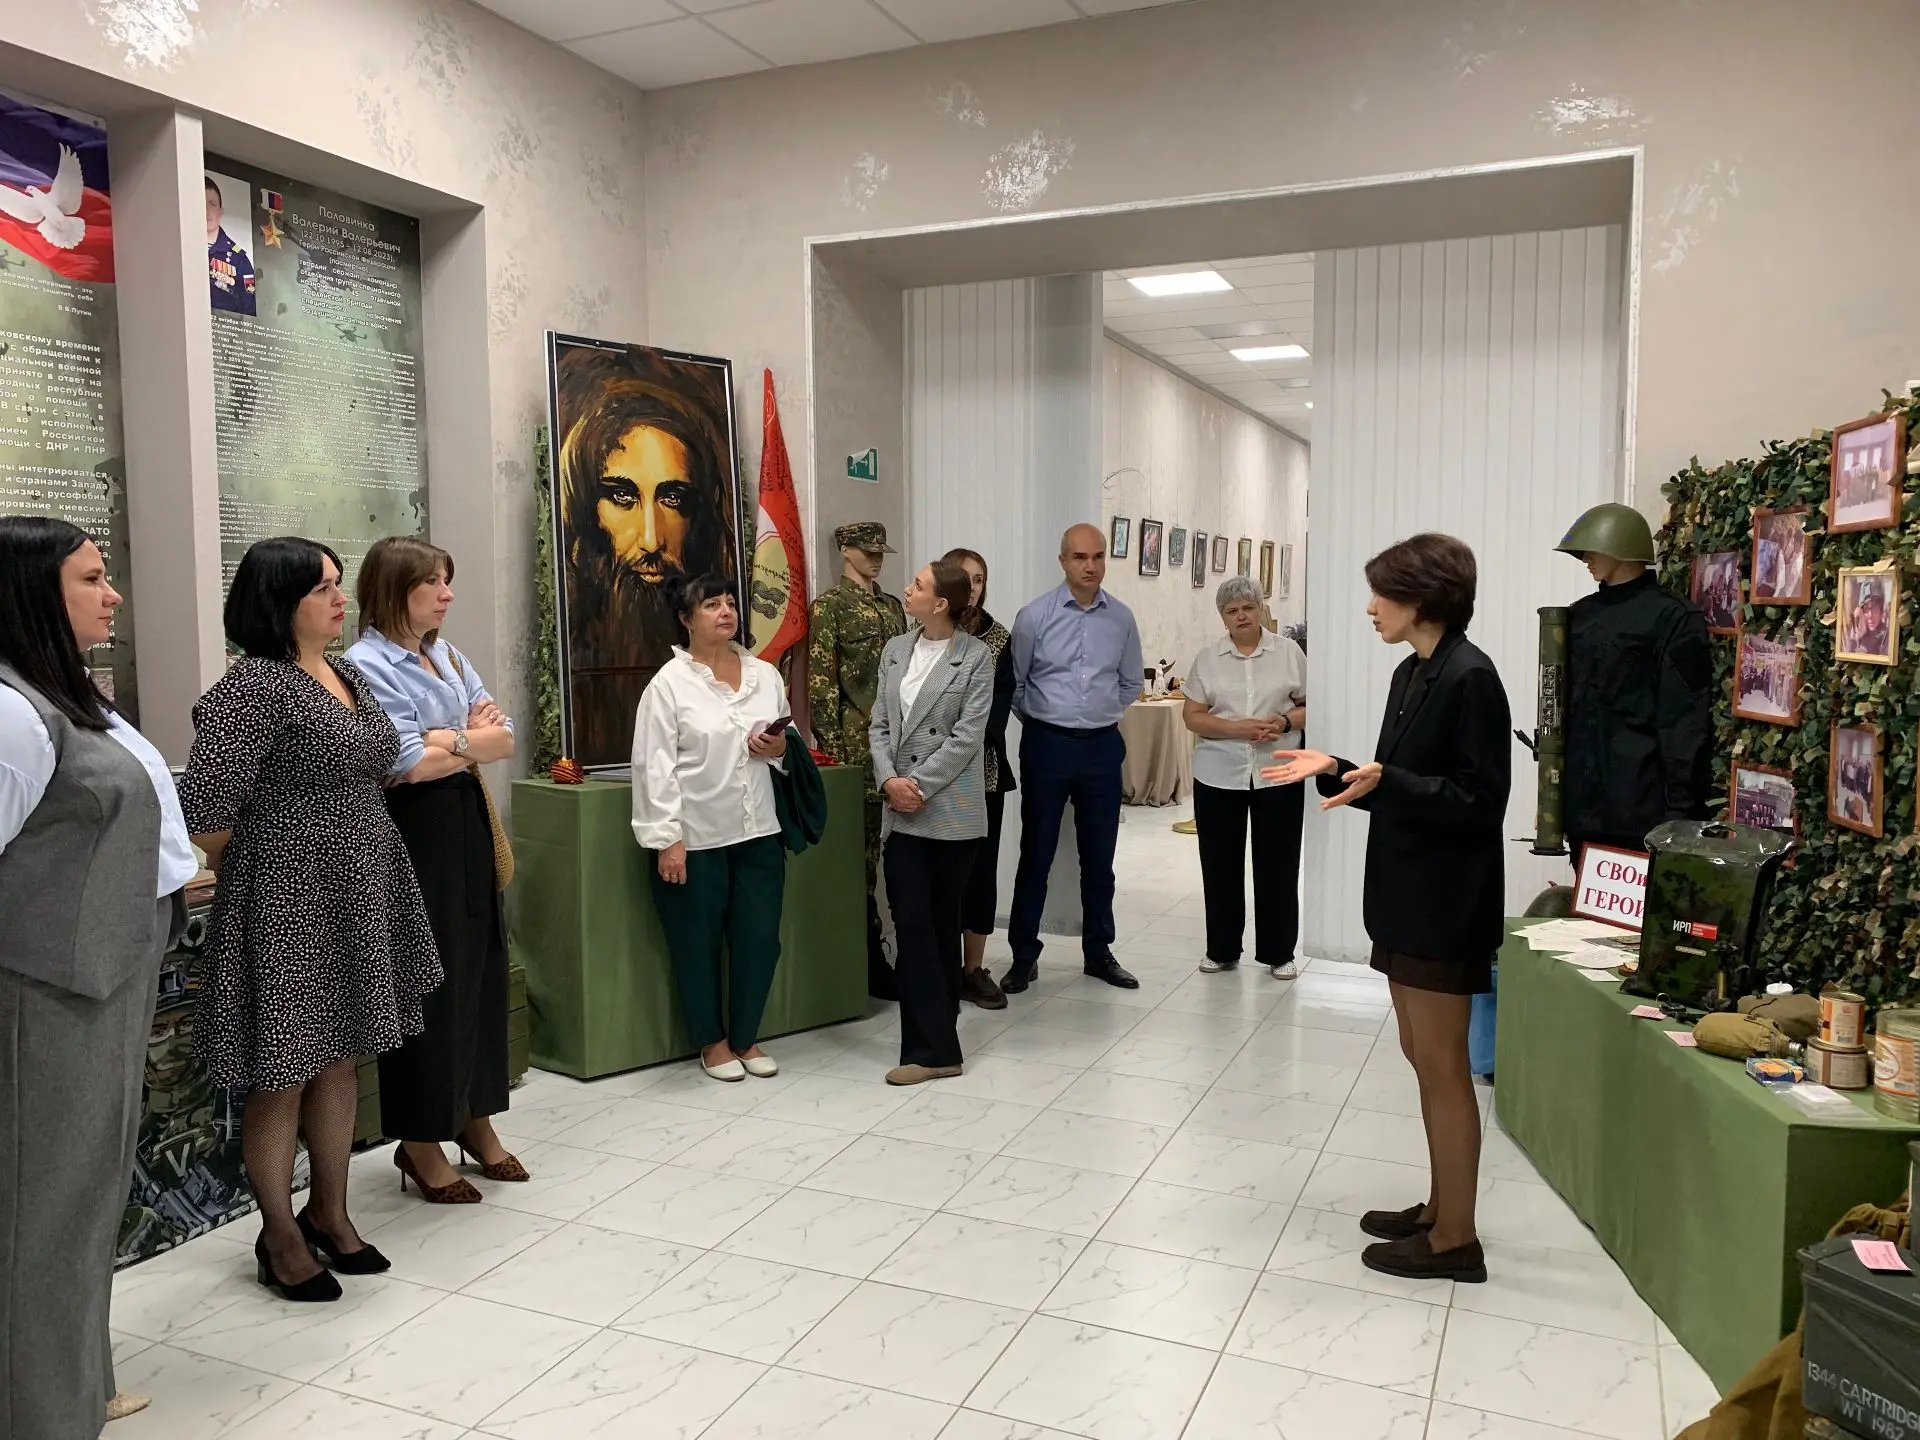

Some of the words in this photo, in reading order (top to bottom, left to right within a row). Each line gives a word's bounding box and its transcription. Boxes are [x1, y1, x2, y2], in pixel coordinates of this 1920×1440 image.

[319, 205, 376, 232] Половинка
[291, 213, 339, 236] Валерий
[341, 227, 402, 254] Валерьевич
[55, 339, 101, 353] времени
[22, 345, 91, 363] обращением
[95, 357, 102, 365] к
[0, 366, 43, 379] принято
[57, 374, 86, 385] ответ
[89, 379, 102, 388] на
[58, 363, 102, 376] военной
[47, 384, 103, 399] республик
[28, 394, 35, 402] о
[45, 396, 88, 408] помощи
[14, 404, 47, 414] связи
[64, 410, 94, 422] этим,
[98, 414, 104, 422] в
[16, 416, 29, 424] во
[41, 419, 105, 433] исполнение
[42, 429, 105, 444] Российской
[46, 441, 69, 452] ДНР
[84, 446, 106, 455] ЛНР
[18, 464, 107, 480] интегрироваться
[16, 476, 69, 488] странами
[71, 479, 108, 491] Запада
[0, 486, 45, 499] ацизма,
[47, 490, 109, 502] русофобия.
[0, 499, 52, 510] ирование
[58, 503, 110, 514] киевским
[63, 514, 110, 525] Минских
[81, 526, 111, 536] НАТО
[1596, 860, 1648, 887] СВОи
[1672, 919, 1692, 934] ИРП
